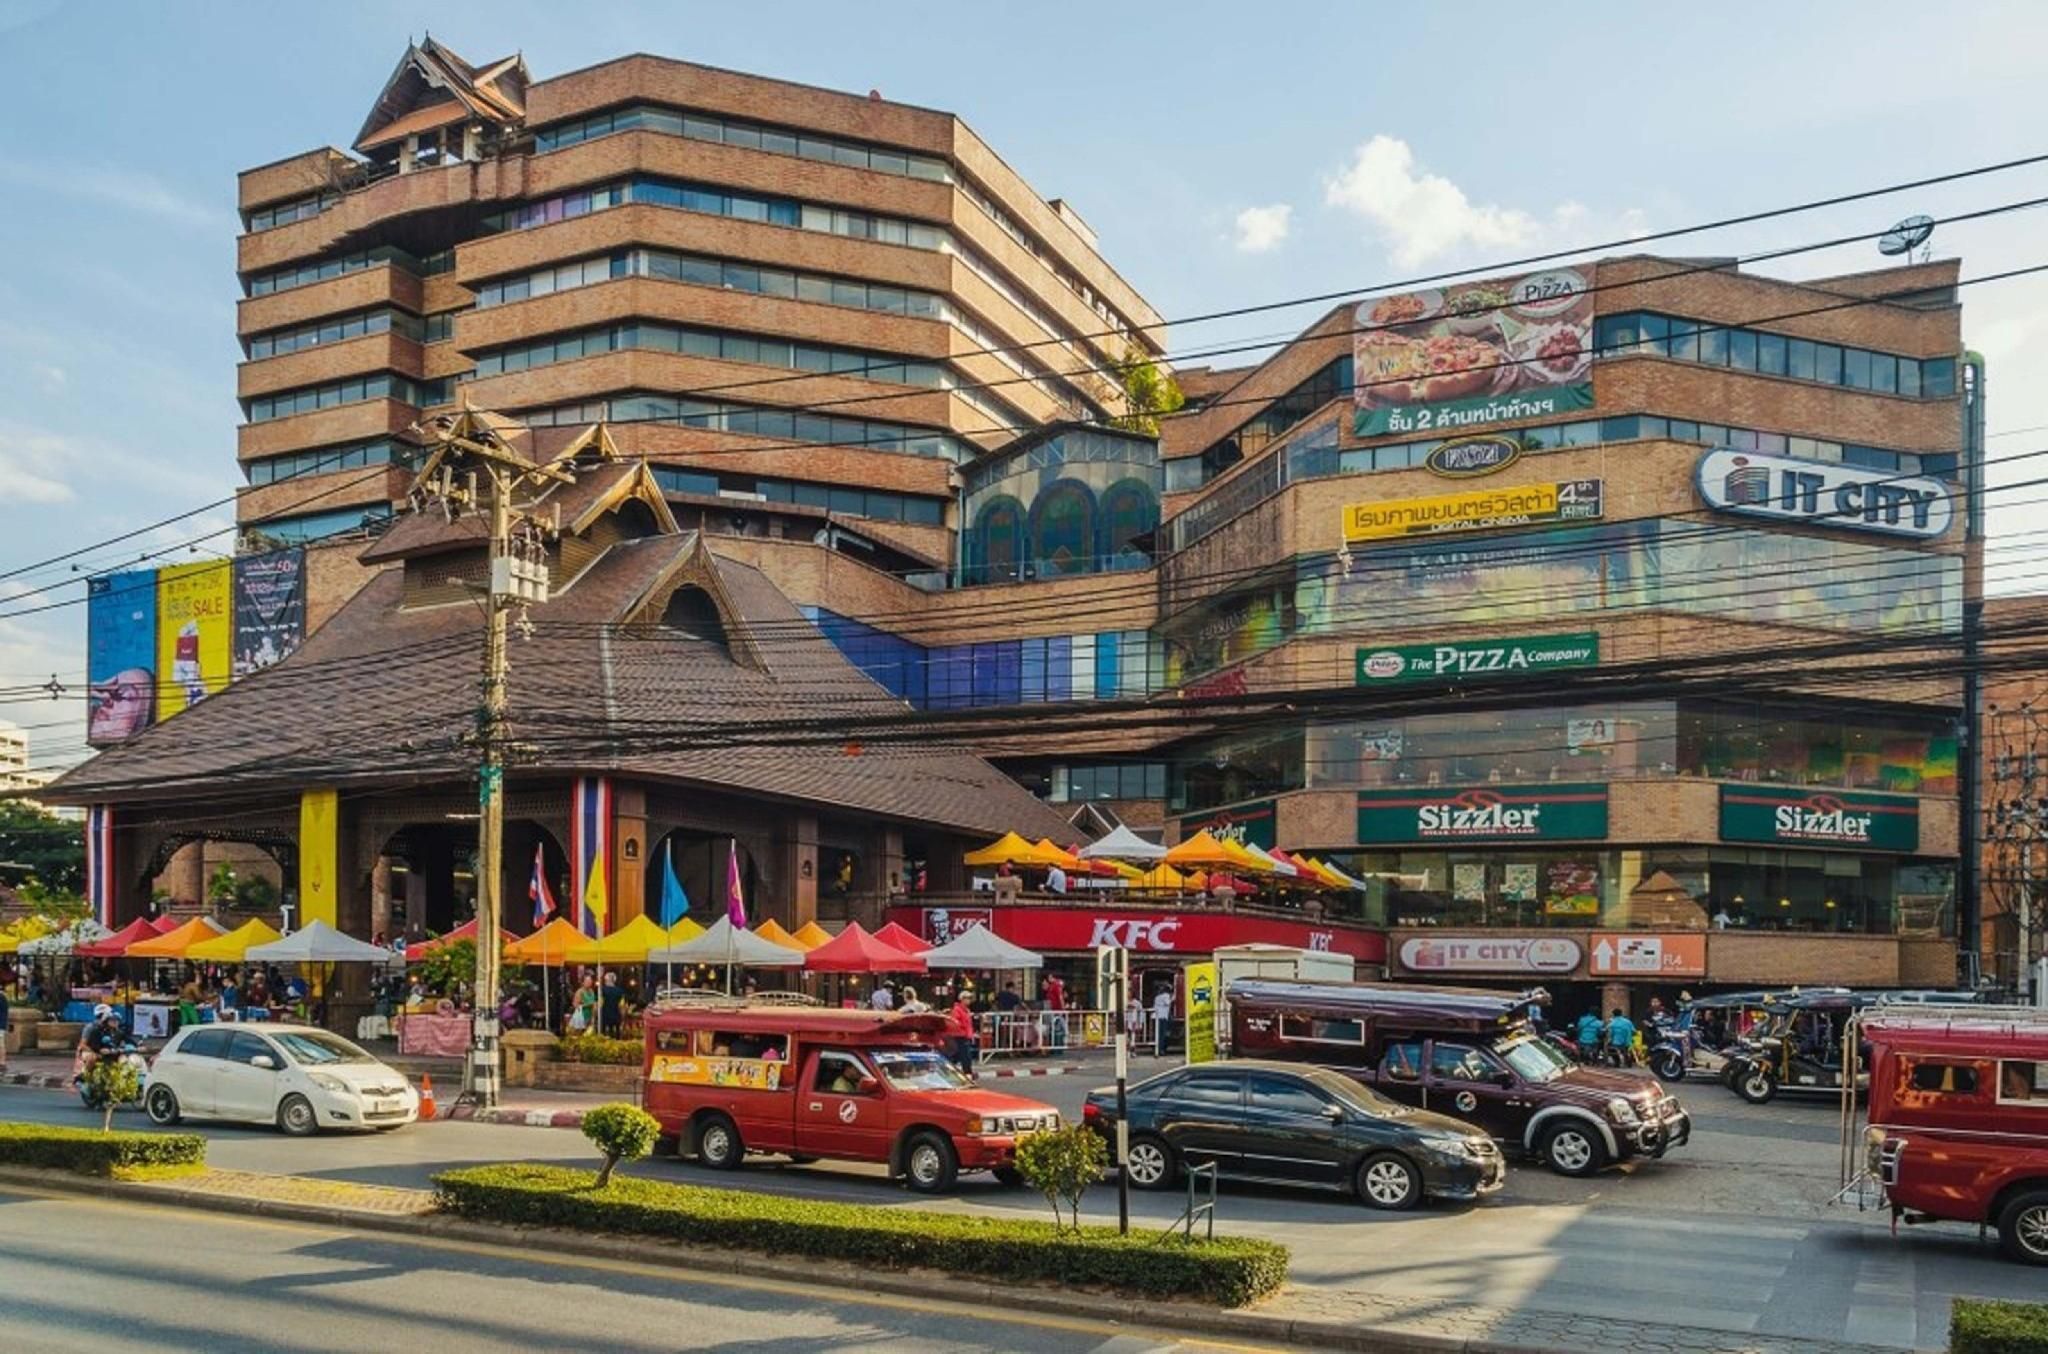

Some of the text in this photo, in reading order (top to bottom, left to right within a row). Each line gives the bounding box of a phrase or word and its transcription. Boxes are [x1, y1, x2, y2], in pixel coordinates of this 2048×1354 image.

[1388, 409, 1412, 431] ชั้น
[1417, 411, 1431, 429] 2
[1781, 469, 1939, 529] IT CITY
[1431, 514, 1530, 532] DIGITAL CINEMA
[193, 597, 223, 617] SALE
[1411, 647, 1591, 674] The PIZZA Company
[1418, 803, 1539, 830] Sizzler
[1775, 805, 1872, 836] Sizzler
[1087, 918, 1180, 950] KFC
[1450, 945, 1470, 959] IT
[1478, 943, 1526, 959] CITY
